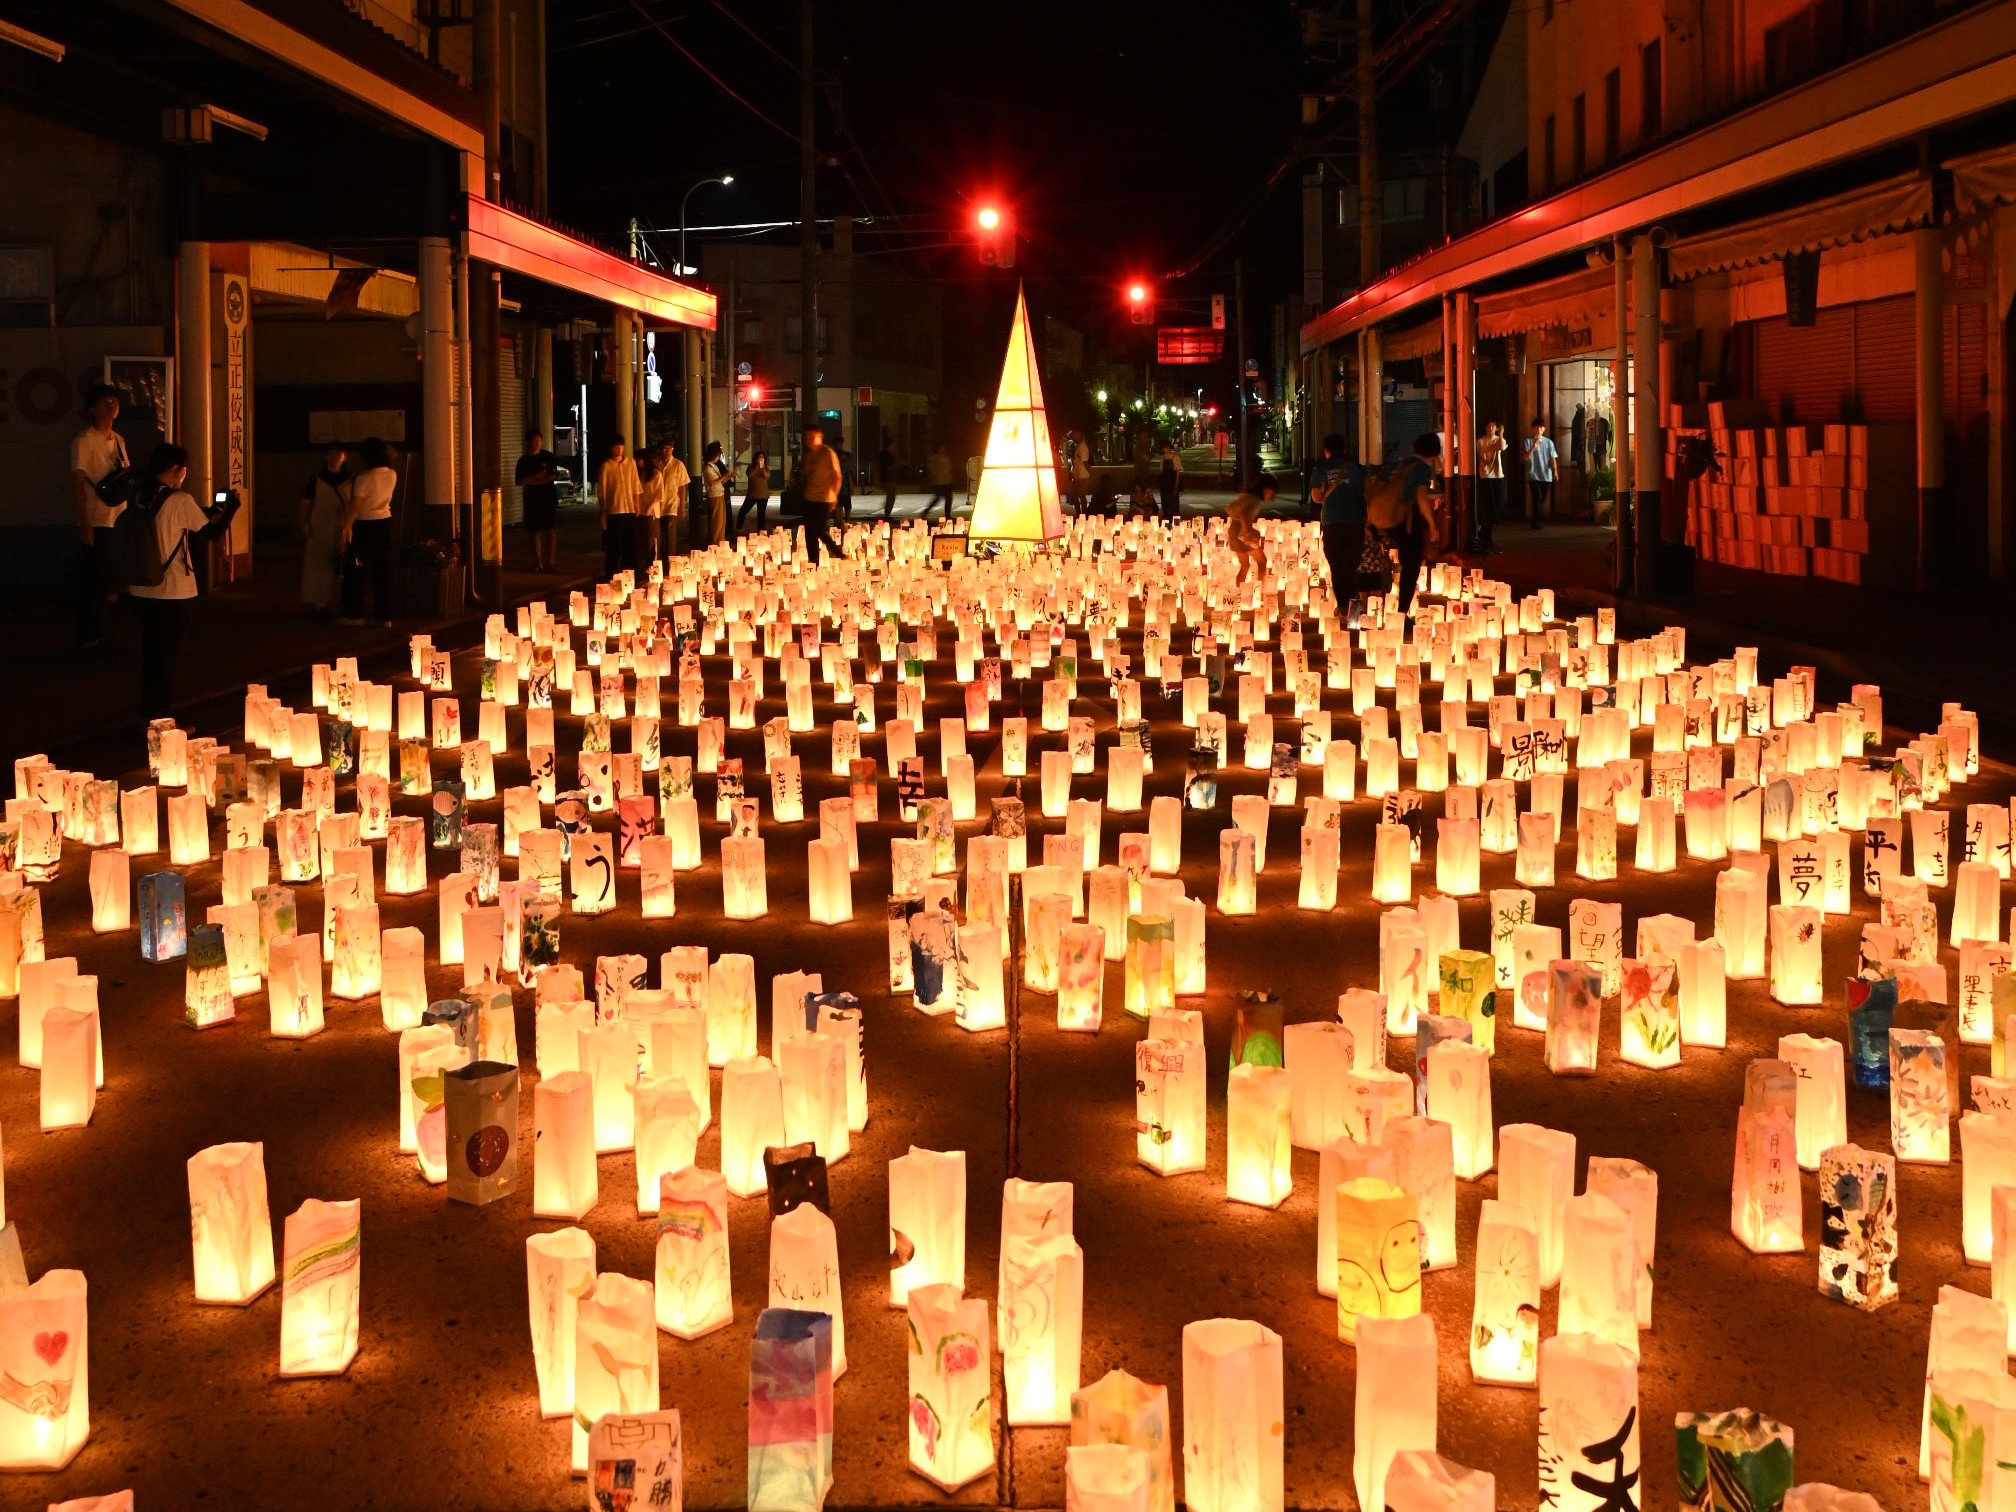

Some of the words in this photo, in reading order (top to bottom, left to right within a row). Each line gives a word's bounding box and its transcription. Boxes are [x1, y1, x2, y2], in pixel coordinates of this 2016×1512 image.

[228, 331, 244, 486] 立正佼成会
[585, 844, 612, 902] う
[1790, 852, 1822, 901] 夢
[1136, 1046, 1185, 1072] 復興
